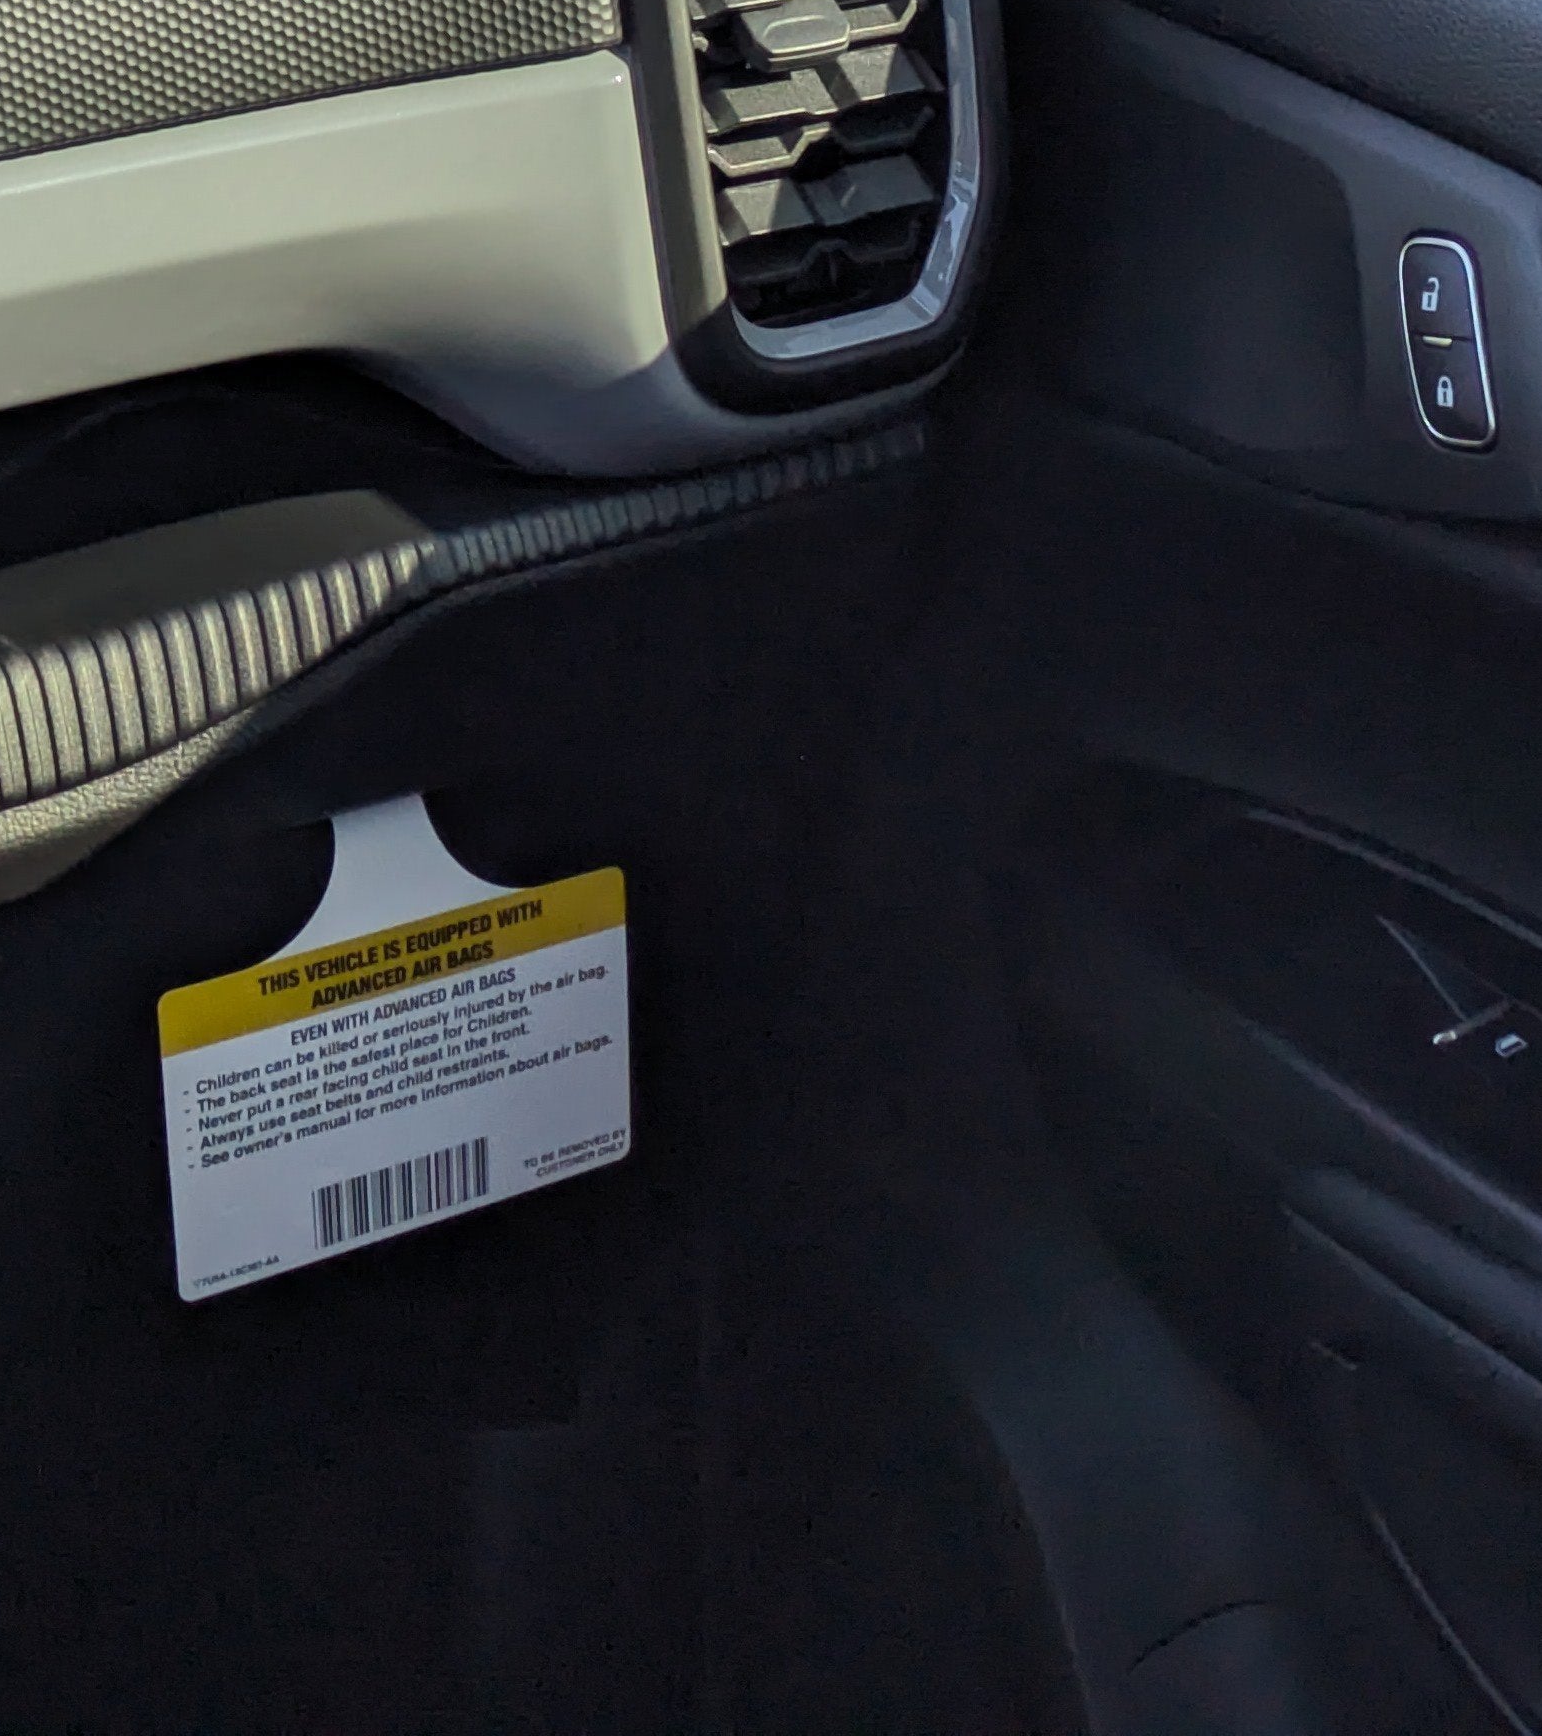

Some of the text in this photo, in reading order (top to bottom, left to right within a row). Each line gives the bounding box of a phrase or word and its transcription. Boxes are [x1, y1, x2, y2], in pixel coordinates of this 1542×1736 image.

[257, 898, 543, 997] THIS VEHICLE IS EQUIPPED WITH
[311, 939, 495, 1010] ADVANCED AIR BAGS
[195, 965, 609, 1095] Children can be killed or seriously injured by the air bag.
[196, 1005, 533, 1114] The back seat is the safest place for Children.
[290, 967, 517, 1047] EVEN WITH ADVANCED AIR BAGS
[198, 1022, 531, 1133] Never put a rear facing child seat in the front.
[199, 1048, 510, 1151] Always use seat belts and child restraints.
[200, 1034, 613, 1169] See owner's manual for more information about air bags.
